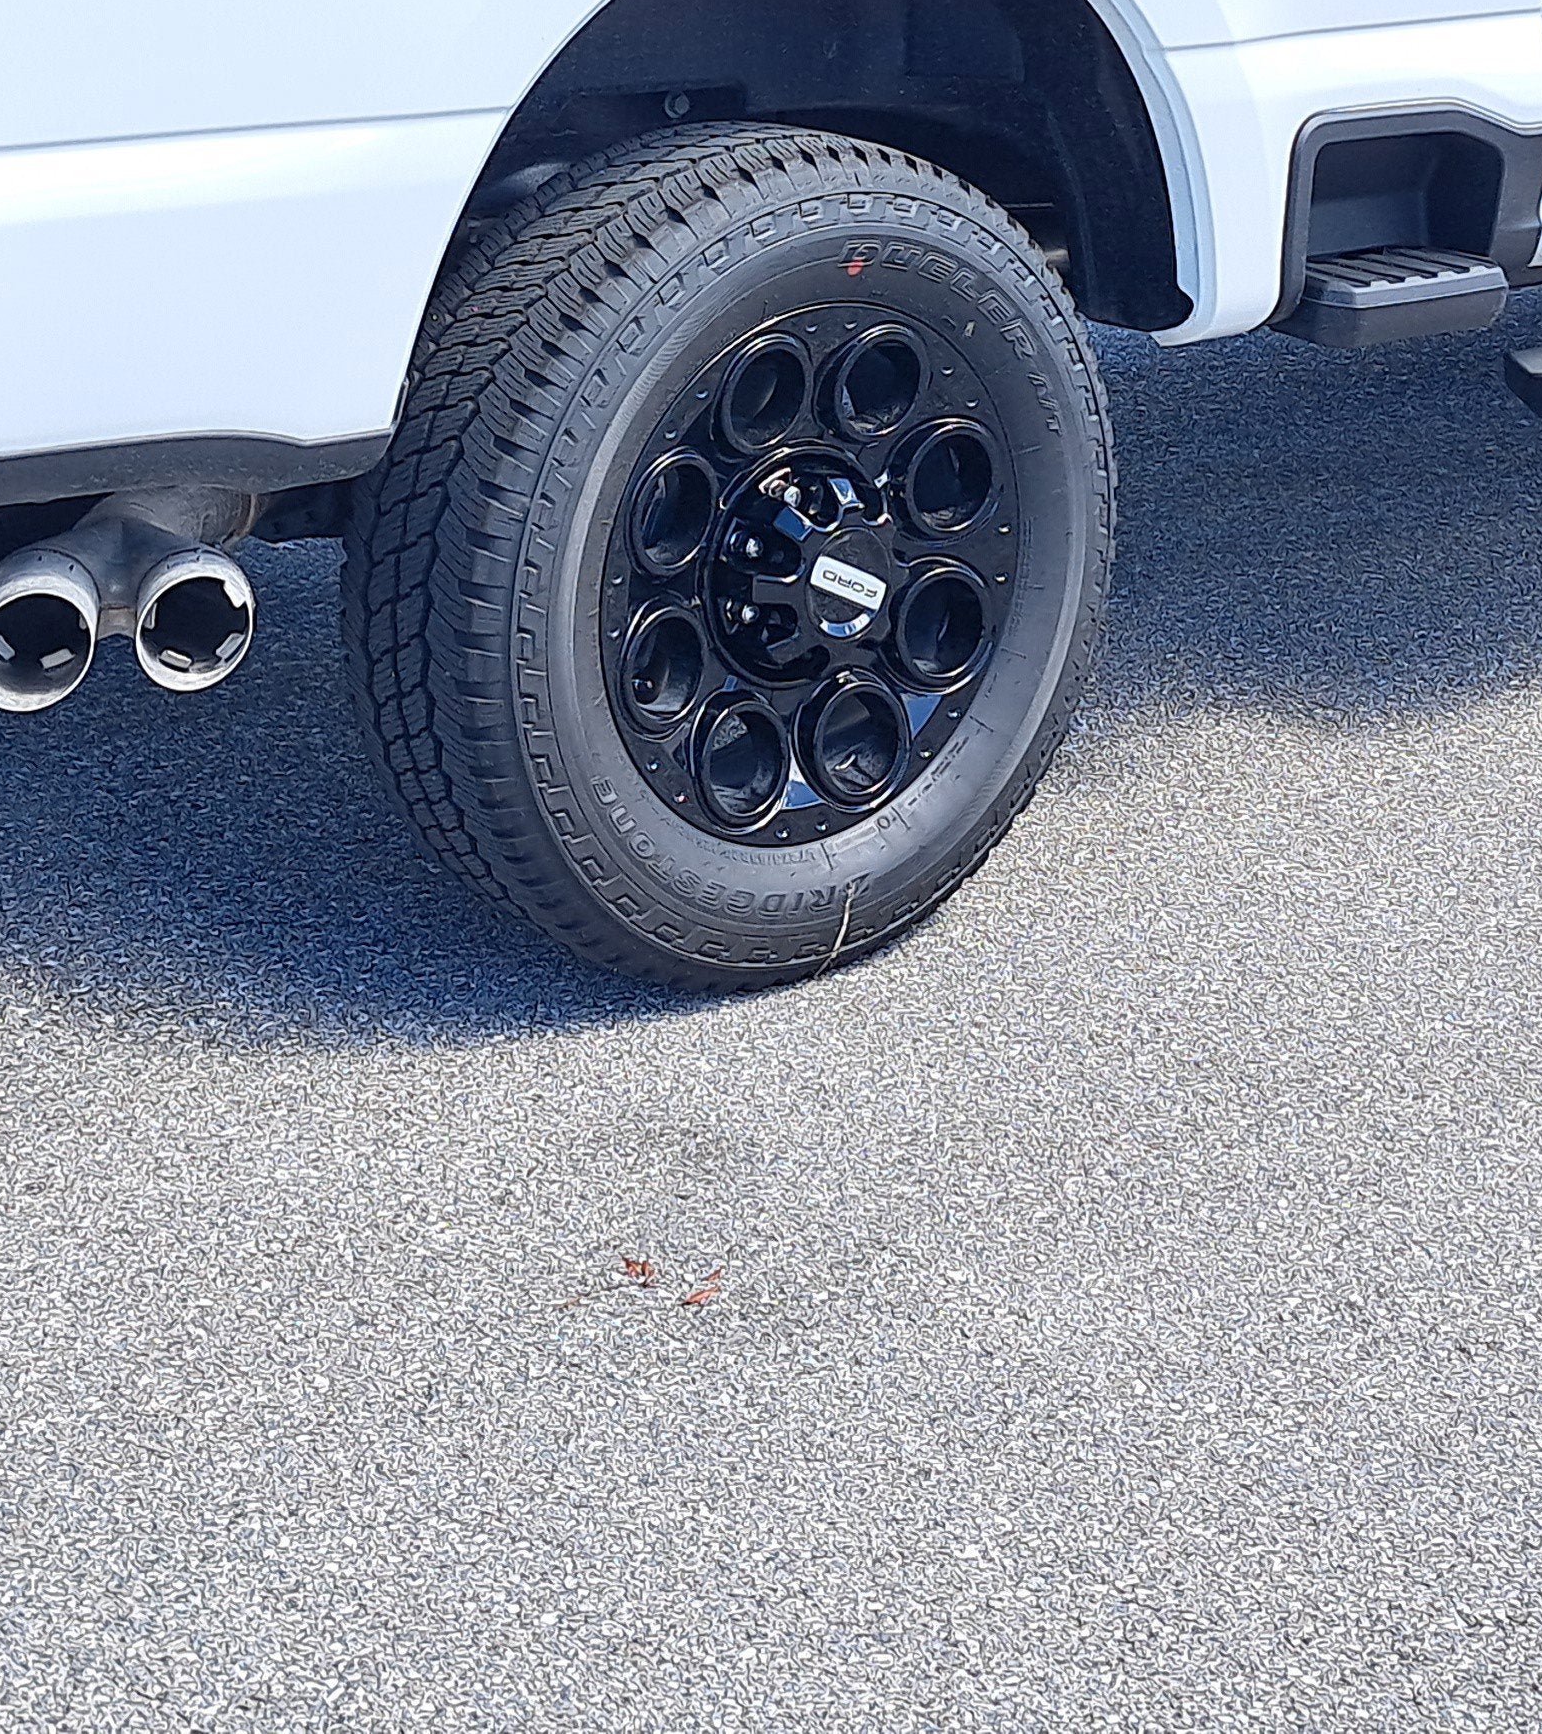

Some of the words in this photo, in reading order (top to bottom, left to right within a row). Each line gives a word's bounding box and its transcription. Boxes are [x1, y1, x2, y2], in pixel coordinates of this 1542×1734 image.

[837, 238, 1039, 360] DUELER
[822, 569, 878, 598] FORD
[590, 774, 873, 920] BRIDGESTONE
